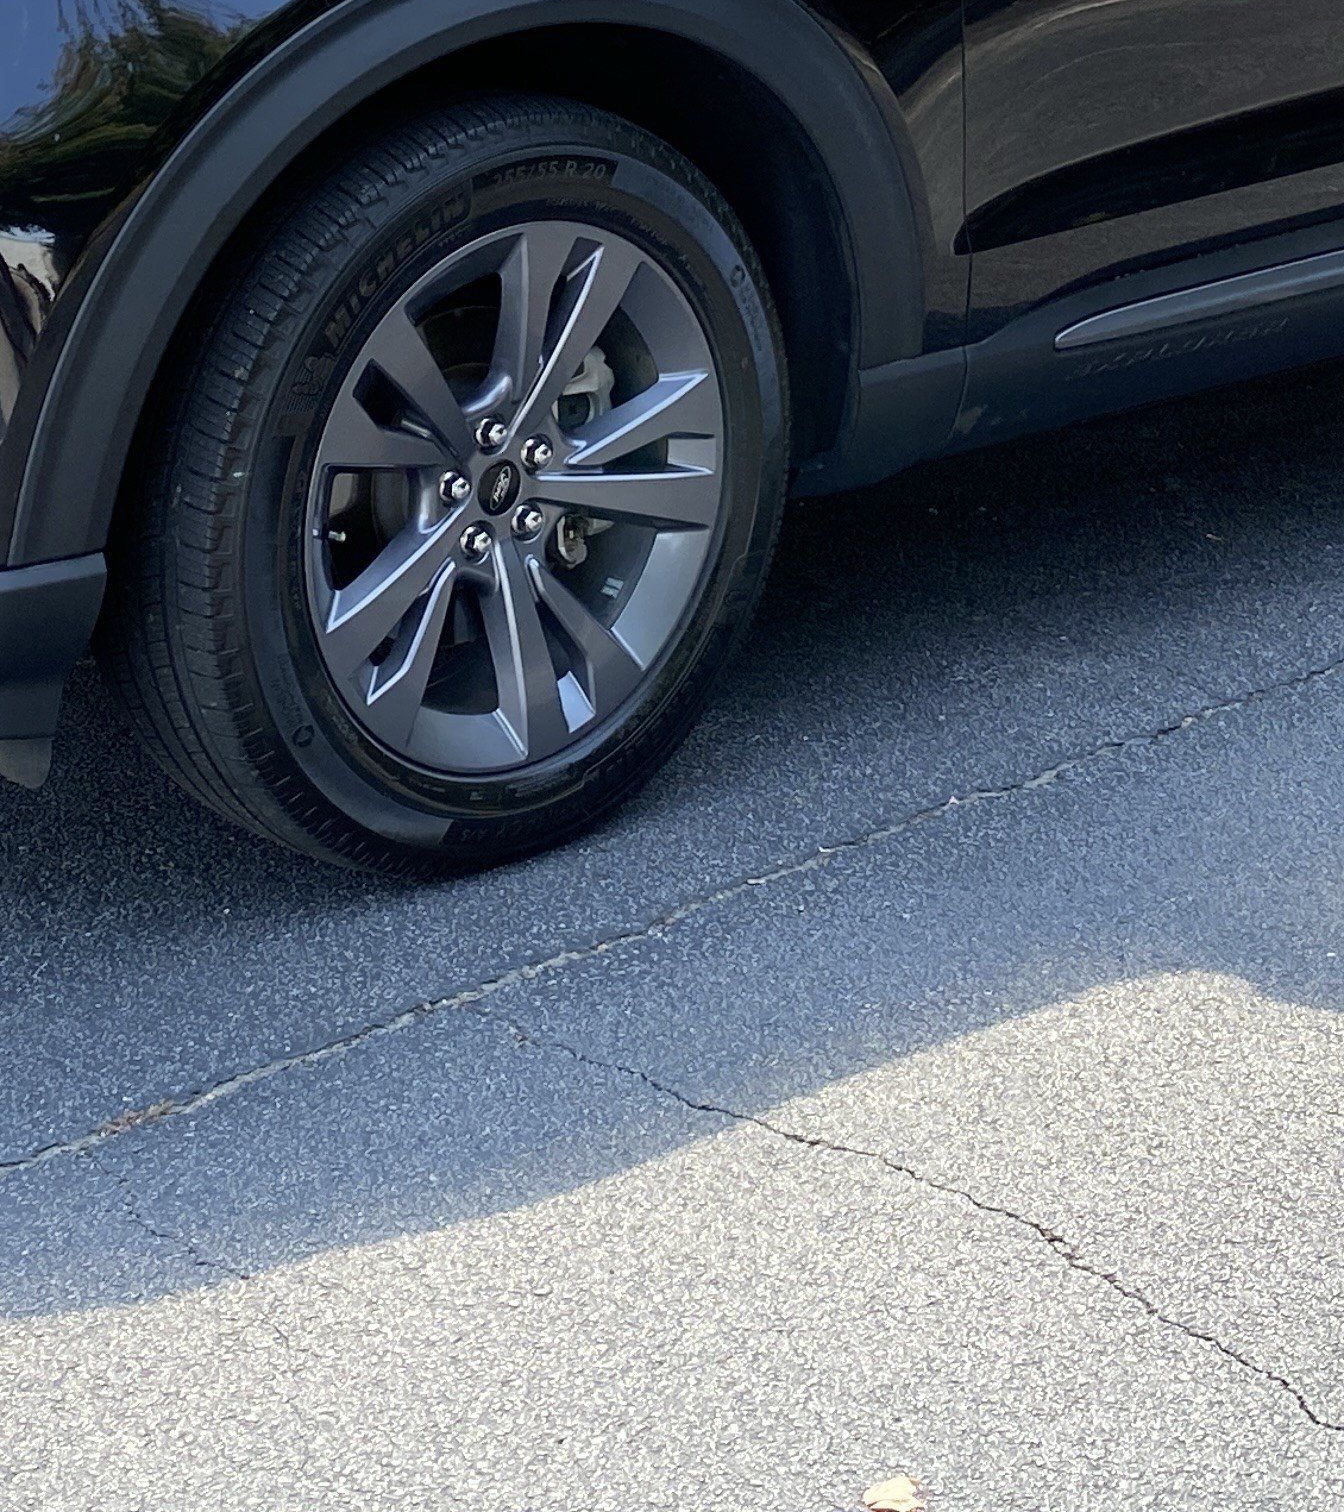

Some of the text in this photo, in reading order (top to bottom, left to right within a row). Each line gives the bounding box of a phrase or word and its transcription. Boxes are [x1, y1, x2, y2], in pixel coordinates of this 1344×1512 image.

[564, 160, 577, 179] R
[584, 162, 607, 180] 20
[323, 190, 472, 348] MICHELIN
